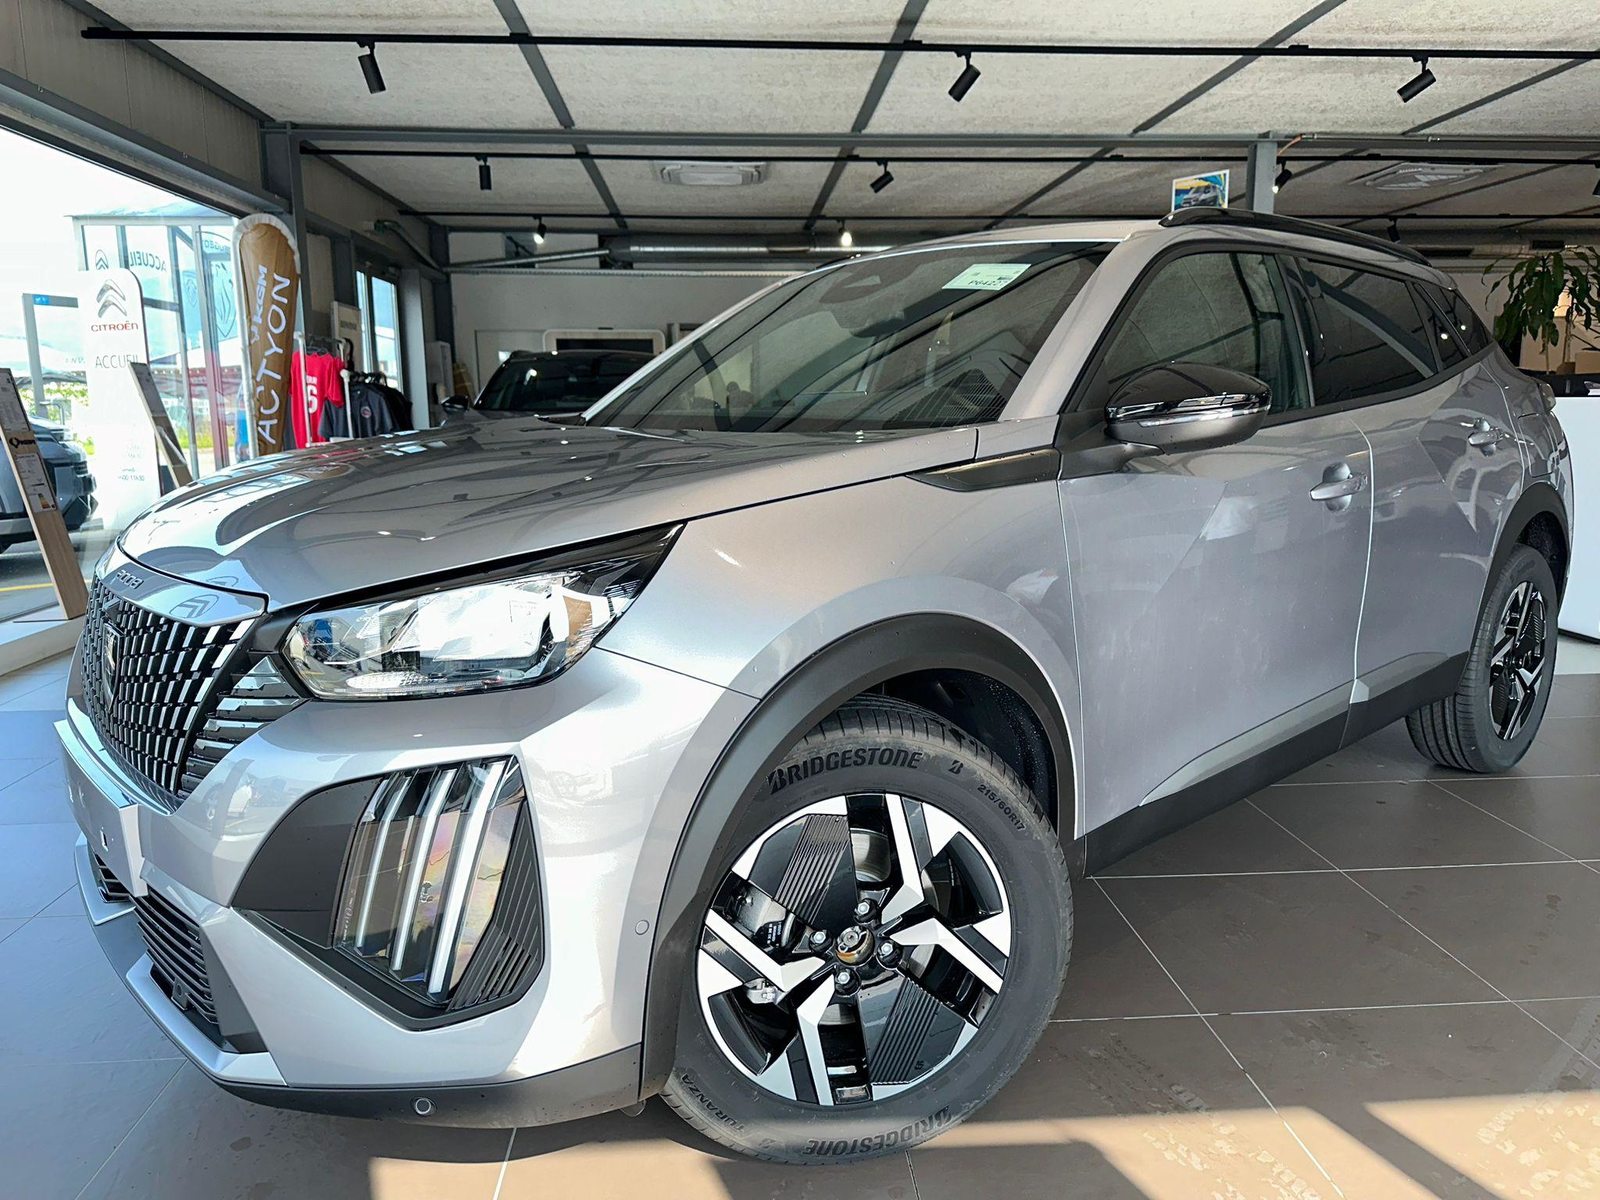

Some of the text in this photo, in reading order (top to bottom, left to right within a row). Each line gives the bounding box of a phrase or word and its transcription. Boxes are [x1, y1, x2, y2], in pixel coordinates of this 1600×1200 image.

[252, 264, 268, 324] KGM
[91, 320, 139, 332] CITROËN
[256, 272, 291, 445] ACTYON
[116, 569, 143, 589] 2008
[766, 748, 923, 795] BRIDGESTONE
[976, 784, 1027, 832] 215/60R17
[681, 1073, 746, 1132] TURANZA
[802, 1105, 951, 1157] BRIDGESTONE
